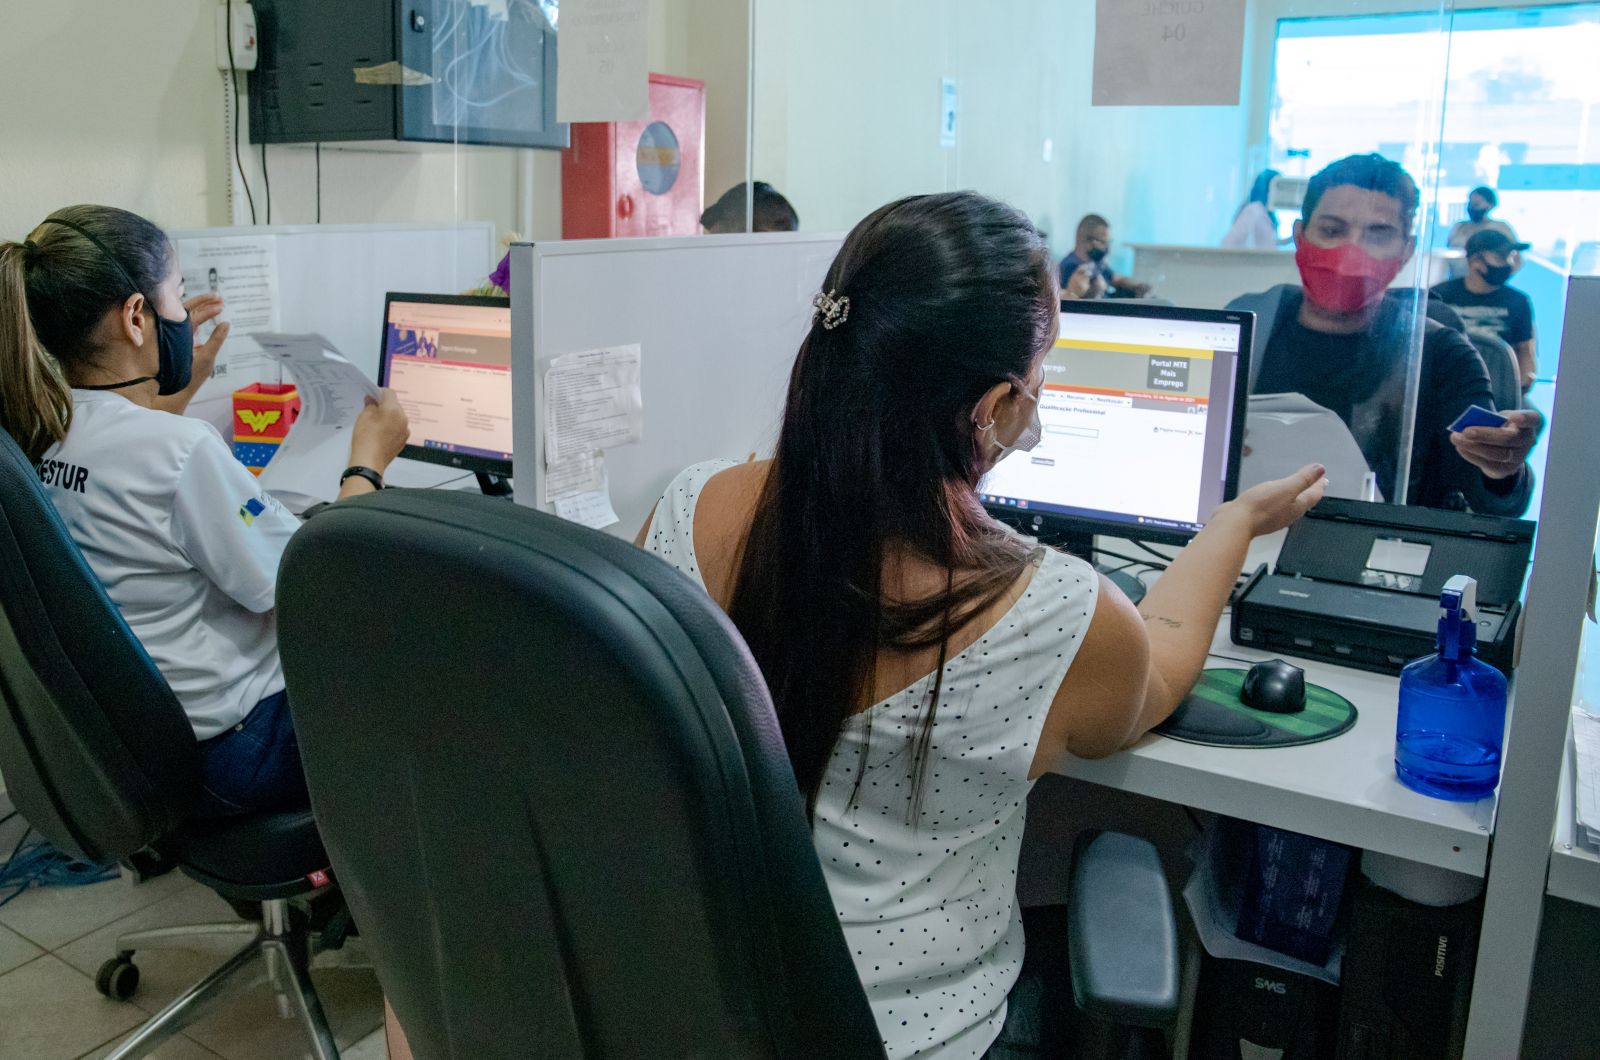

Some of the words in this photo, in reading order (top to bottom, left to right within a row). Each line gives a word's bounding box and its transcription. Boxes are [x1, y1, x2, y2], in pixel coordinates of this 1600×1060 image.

[1151, 359, 1172, 367] Portal
[1173, 361, 1188, 369] MTE
[1160, 369, 1177, 377] Mais
[1153, 378, 1184, 388] Emprego
[37, 459, 88, 494] ESTUR
[1434, 936, 1448, 977] POSITIVO
[1255, 977, 1287, 995] SMS
